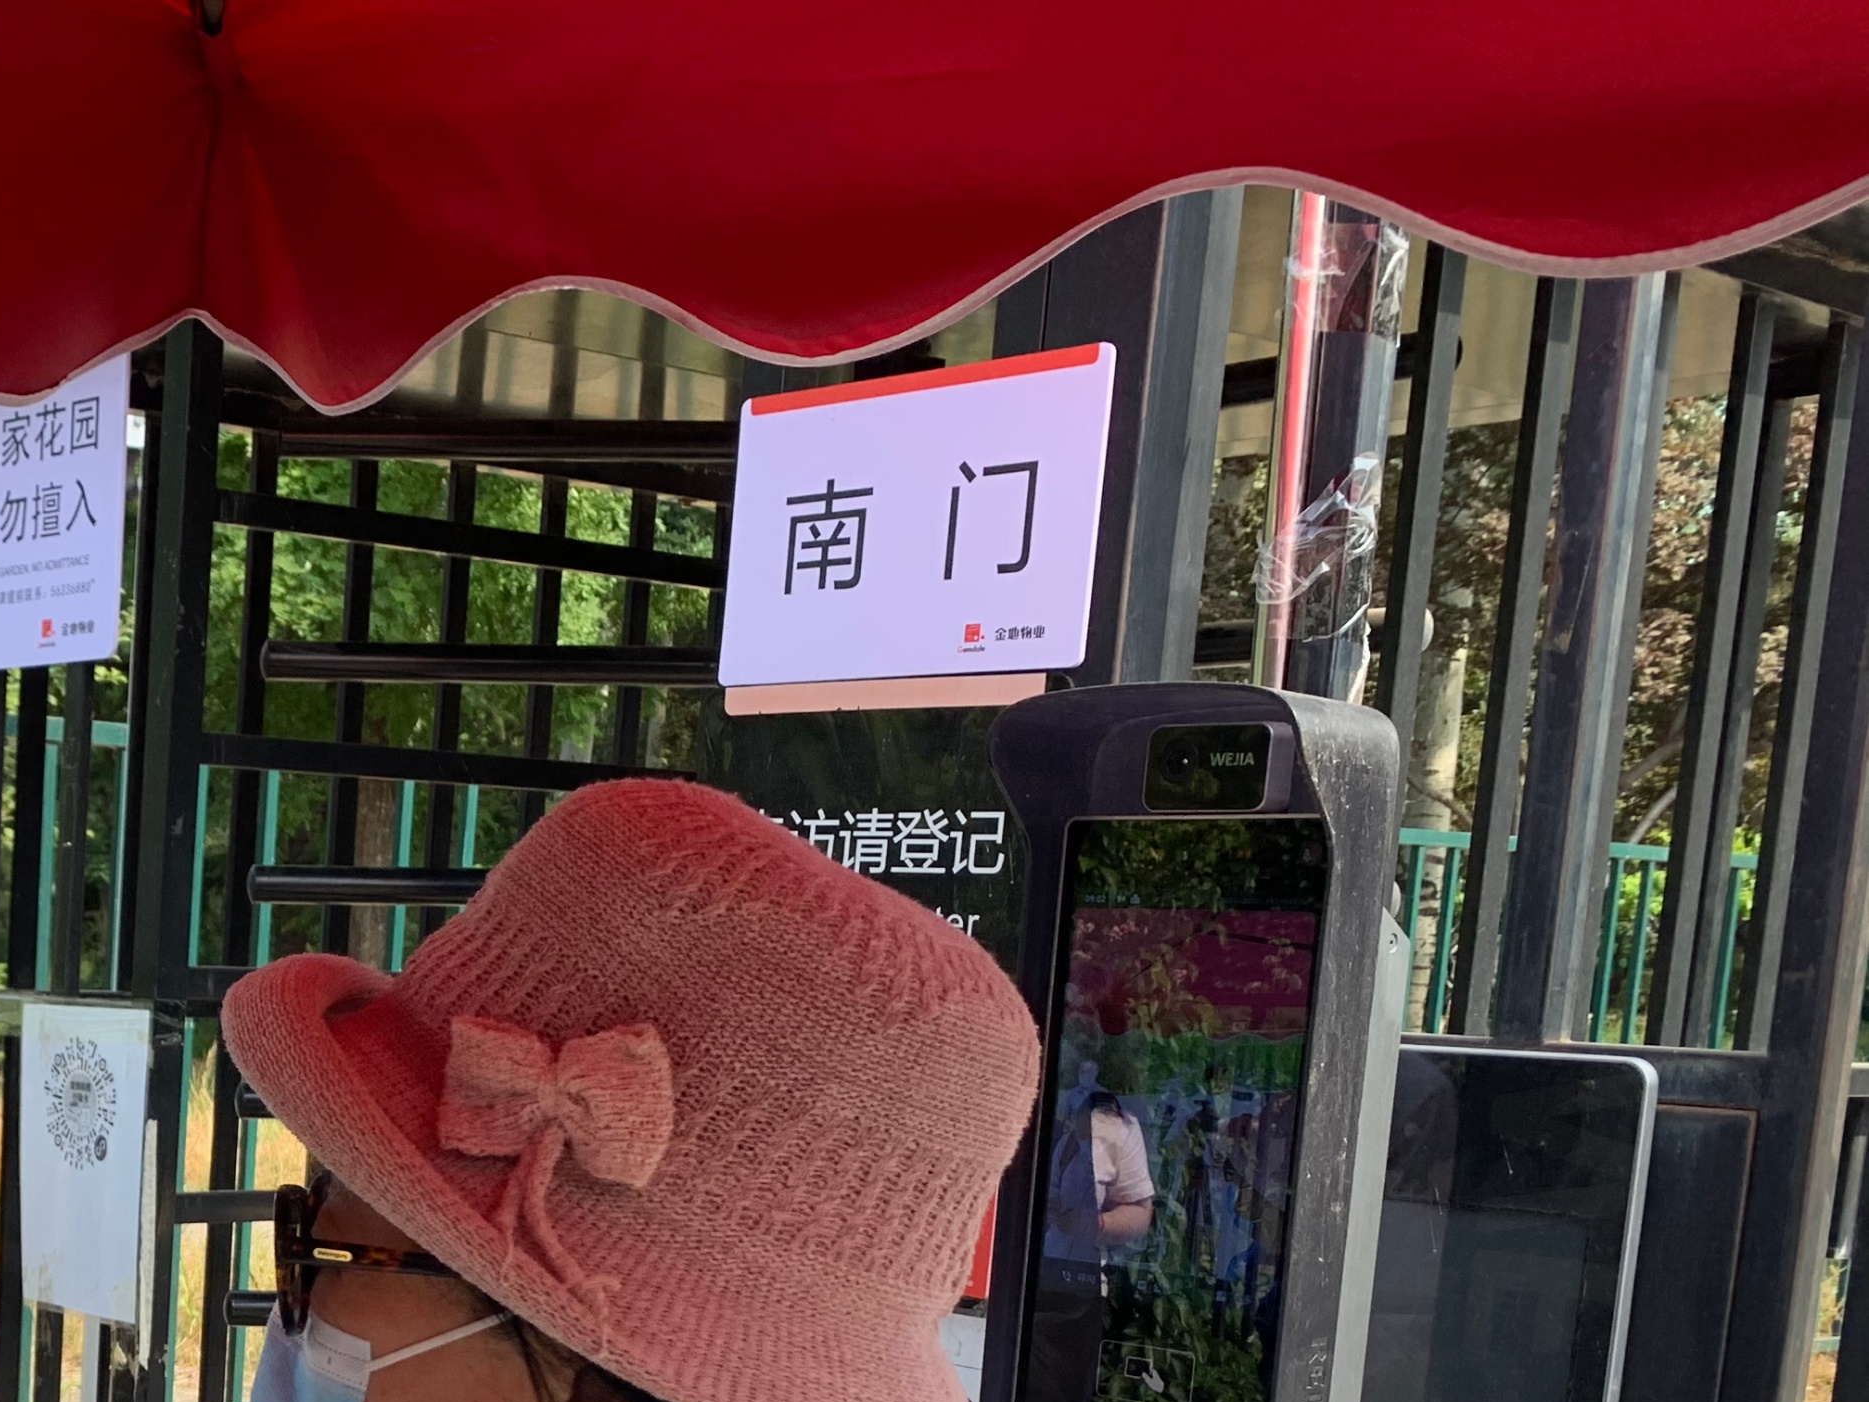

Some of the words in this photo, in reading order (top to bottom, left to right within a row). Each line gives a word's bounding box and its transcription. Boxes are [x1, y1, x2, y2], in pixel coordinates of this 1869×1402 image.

[783, 459, 1039, 596] 南门
[994, 625, 1045, 641] 金地物业
[1210, 751, 1255, 767] WEJIA
[759, 808, 1006, 875] 访请登记
